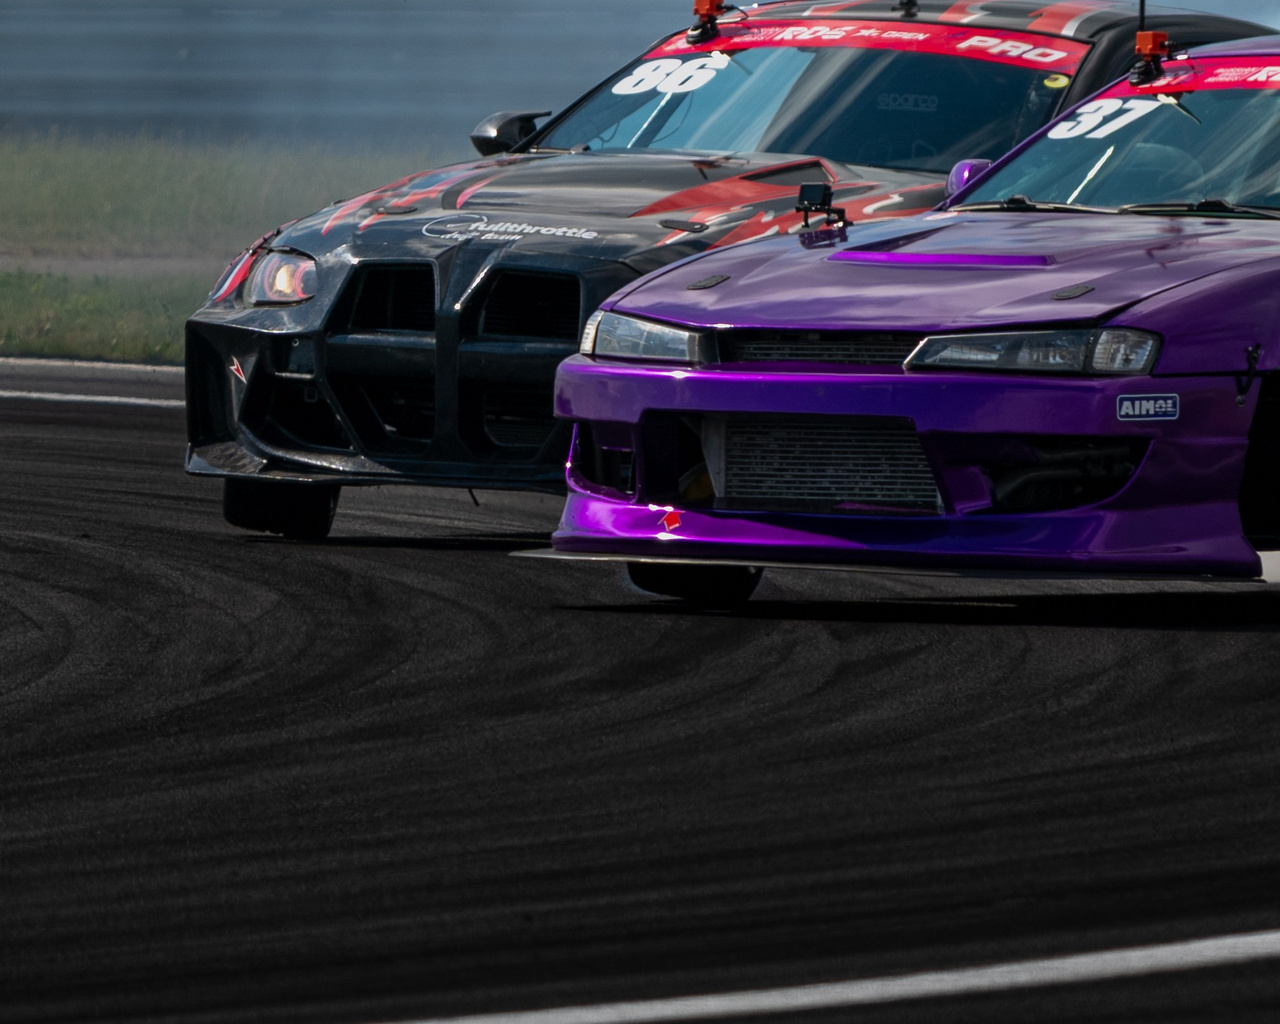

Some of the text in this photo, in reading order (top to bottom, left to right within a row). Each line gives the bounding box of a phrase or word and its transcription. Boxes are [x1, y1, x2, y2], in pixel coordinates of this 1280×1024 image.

[773, 25, 857, 41] RDS
[880, 30, 931, 41] OPEN
[956, 35, 1068, 63] PRO
[611, 57, 729, 94] 86
[877, 92, 939, 111] sparco
[1047, 98, 1162, 139] 37
[468, 222, 598, 239] fullthrottle
[1120, 400, 1176, 415] AIMOL
